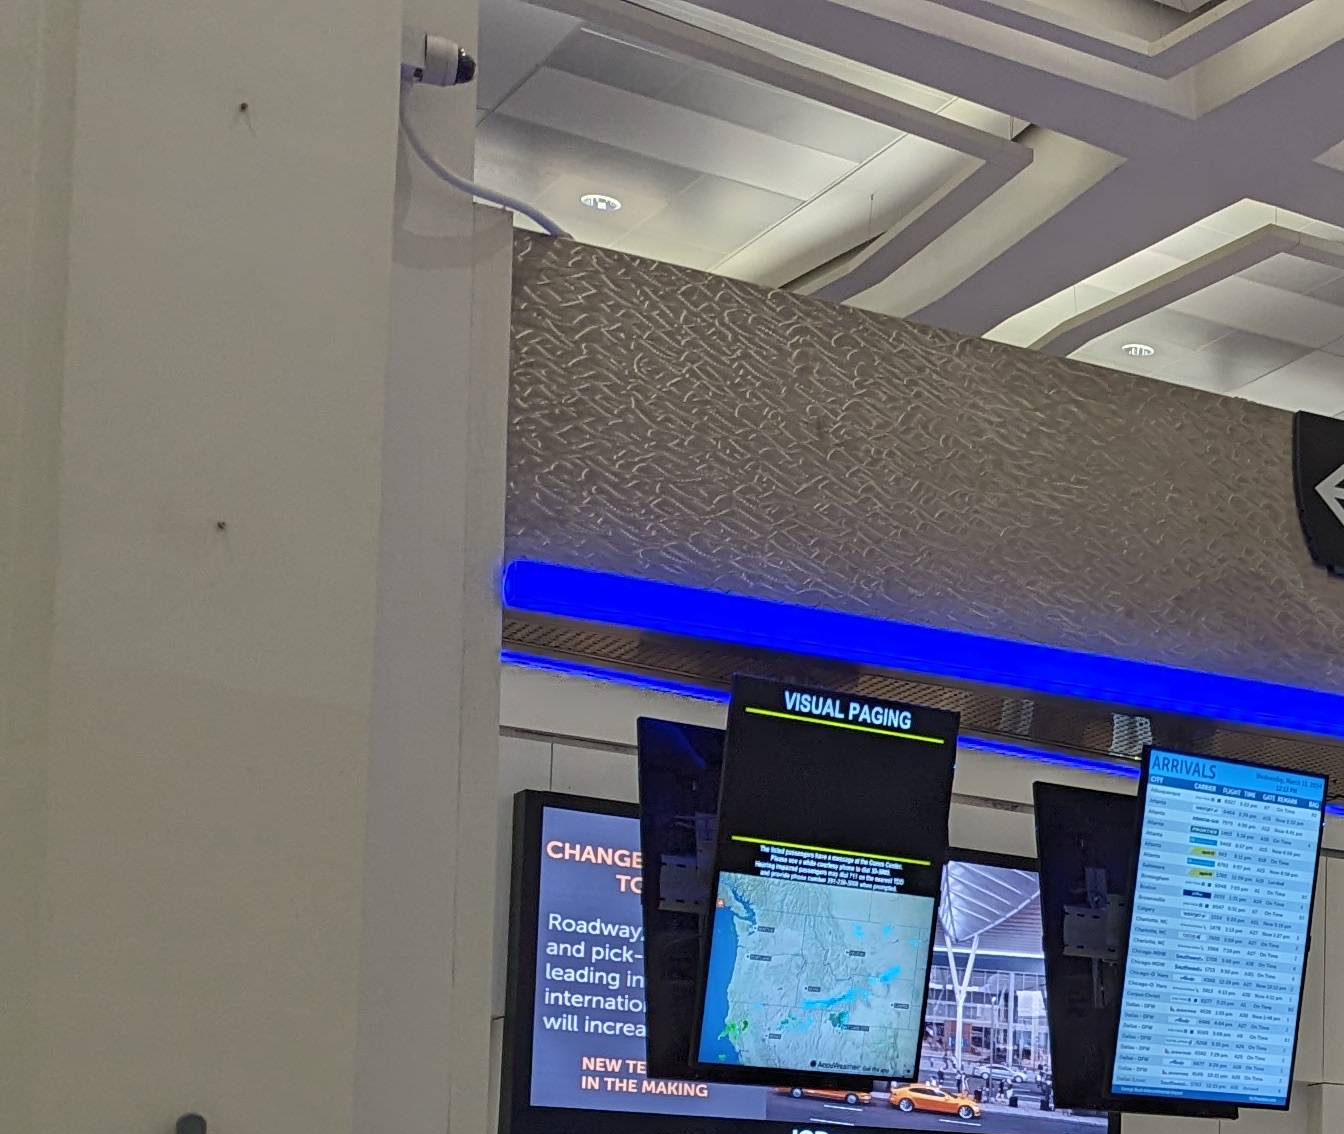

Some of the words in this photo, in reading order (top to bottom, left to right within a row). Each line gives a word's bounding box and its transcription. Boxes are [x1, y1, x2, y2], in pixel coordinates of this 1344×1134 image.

[784, 690, 845, 720] VISUAL
[848, 703, 912, 730] PAGING
[1152, 755, 1216, 779] ARRIVALS
[1194, 783, 1217, 792] CARRIER
[546, 941, 585, 958] and
[592, 945, 643, 963] pick-
[545, 963, 620, 989] leading
[627, 971, 644, 988] in
[544, 988, 646, 1013] internatio
[543, 1014, 578, 1031] will
[585, 1018, 646, 1037] increa
[582, 1057, 622, 1073] NEW
[626, 1060, 646, 1075] TE
[581, 1077, 600, 1090] IN
[605, 1078, 637, 1092] THE
[642, 1082, 708, 1097] MAKING
